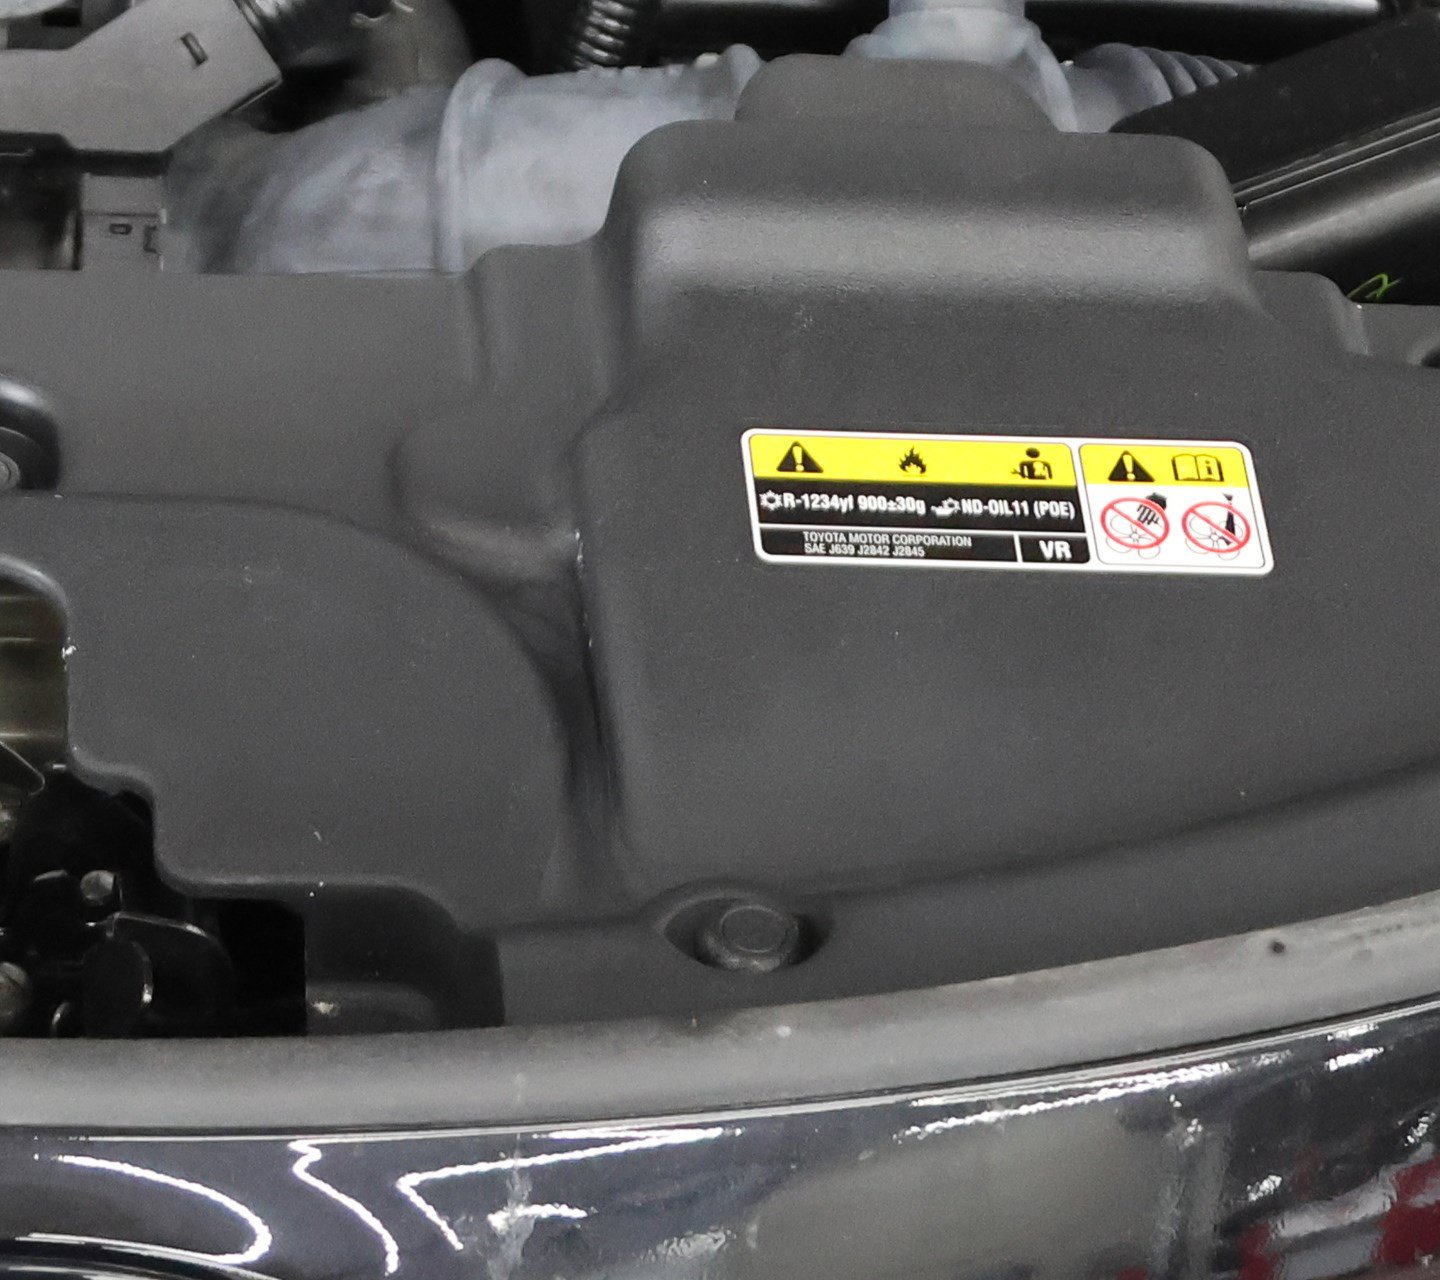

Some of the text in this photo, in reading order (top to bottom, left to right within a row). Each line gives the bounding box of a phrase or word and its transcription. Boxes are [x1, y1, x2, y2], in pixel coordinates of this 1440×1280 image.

[782, 493, 854, 514] R-1234yf
[858, 495, 925, 516] 900±30g
[1033, 500, 1075, 520] (POE)
[803, 531, 972, 547] TOYOTA MOTOR CORPORATION
[804, 542, 925, 557] SAE J639 J2842 J2845
[1039, 540, 1072, 559] VR
